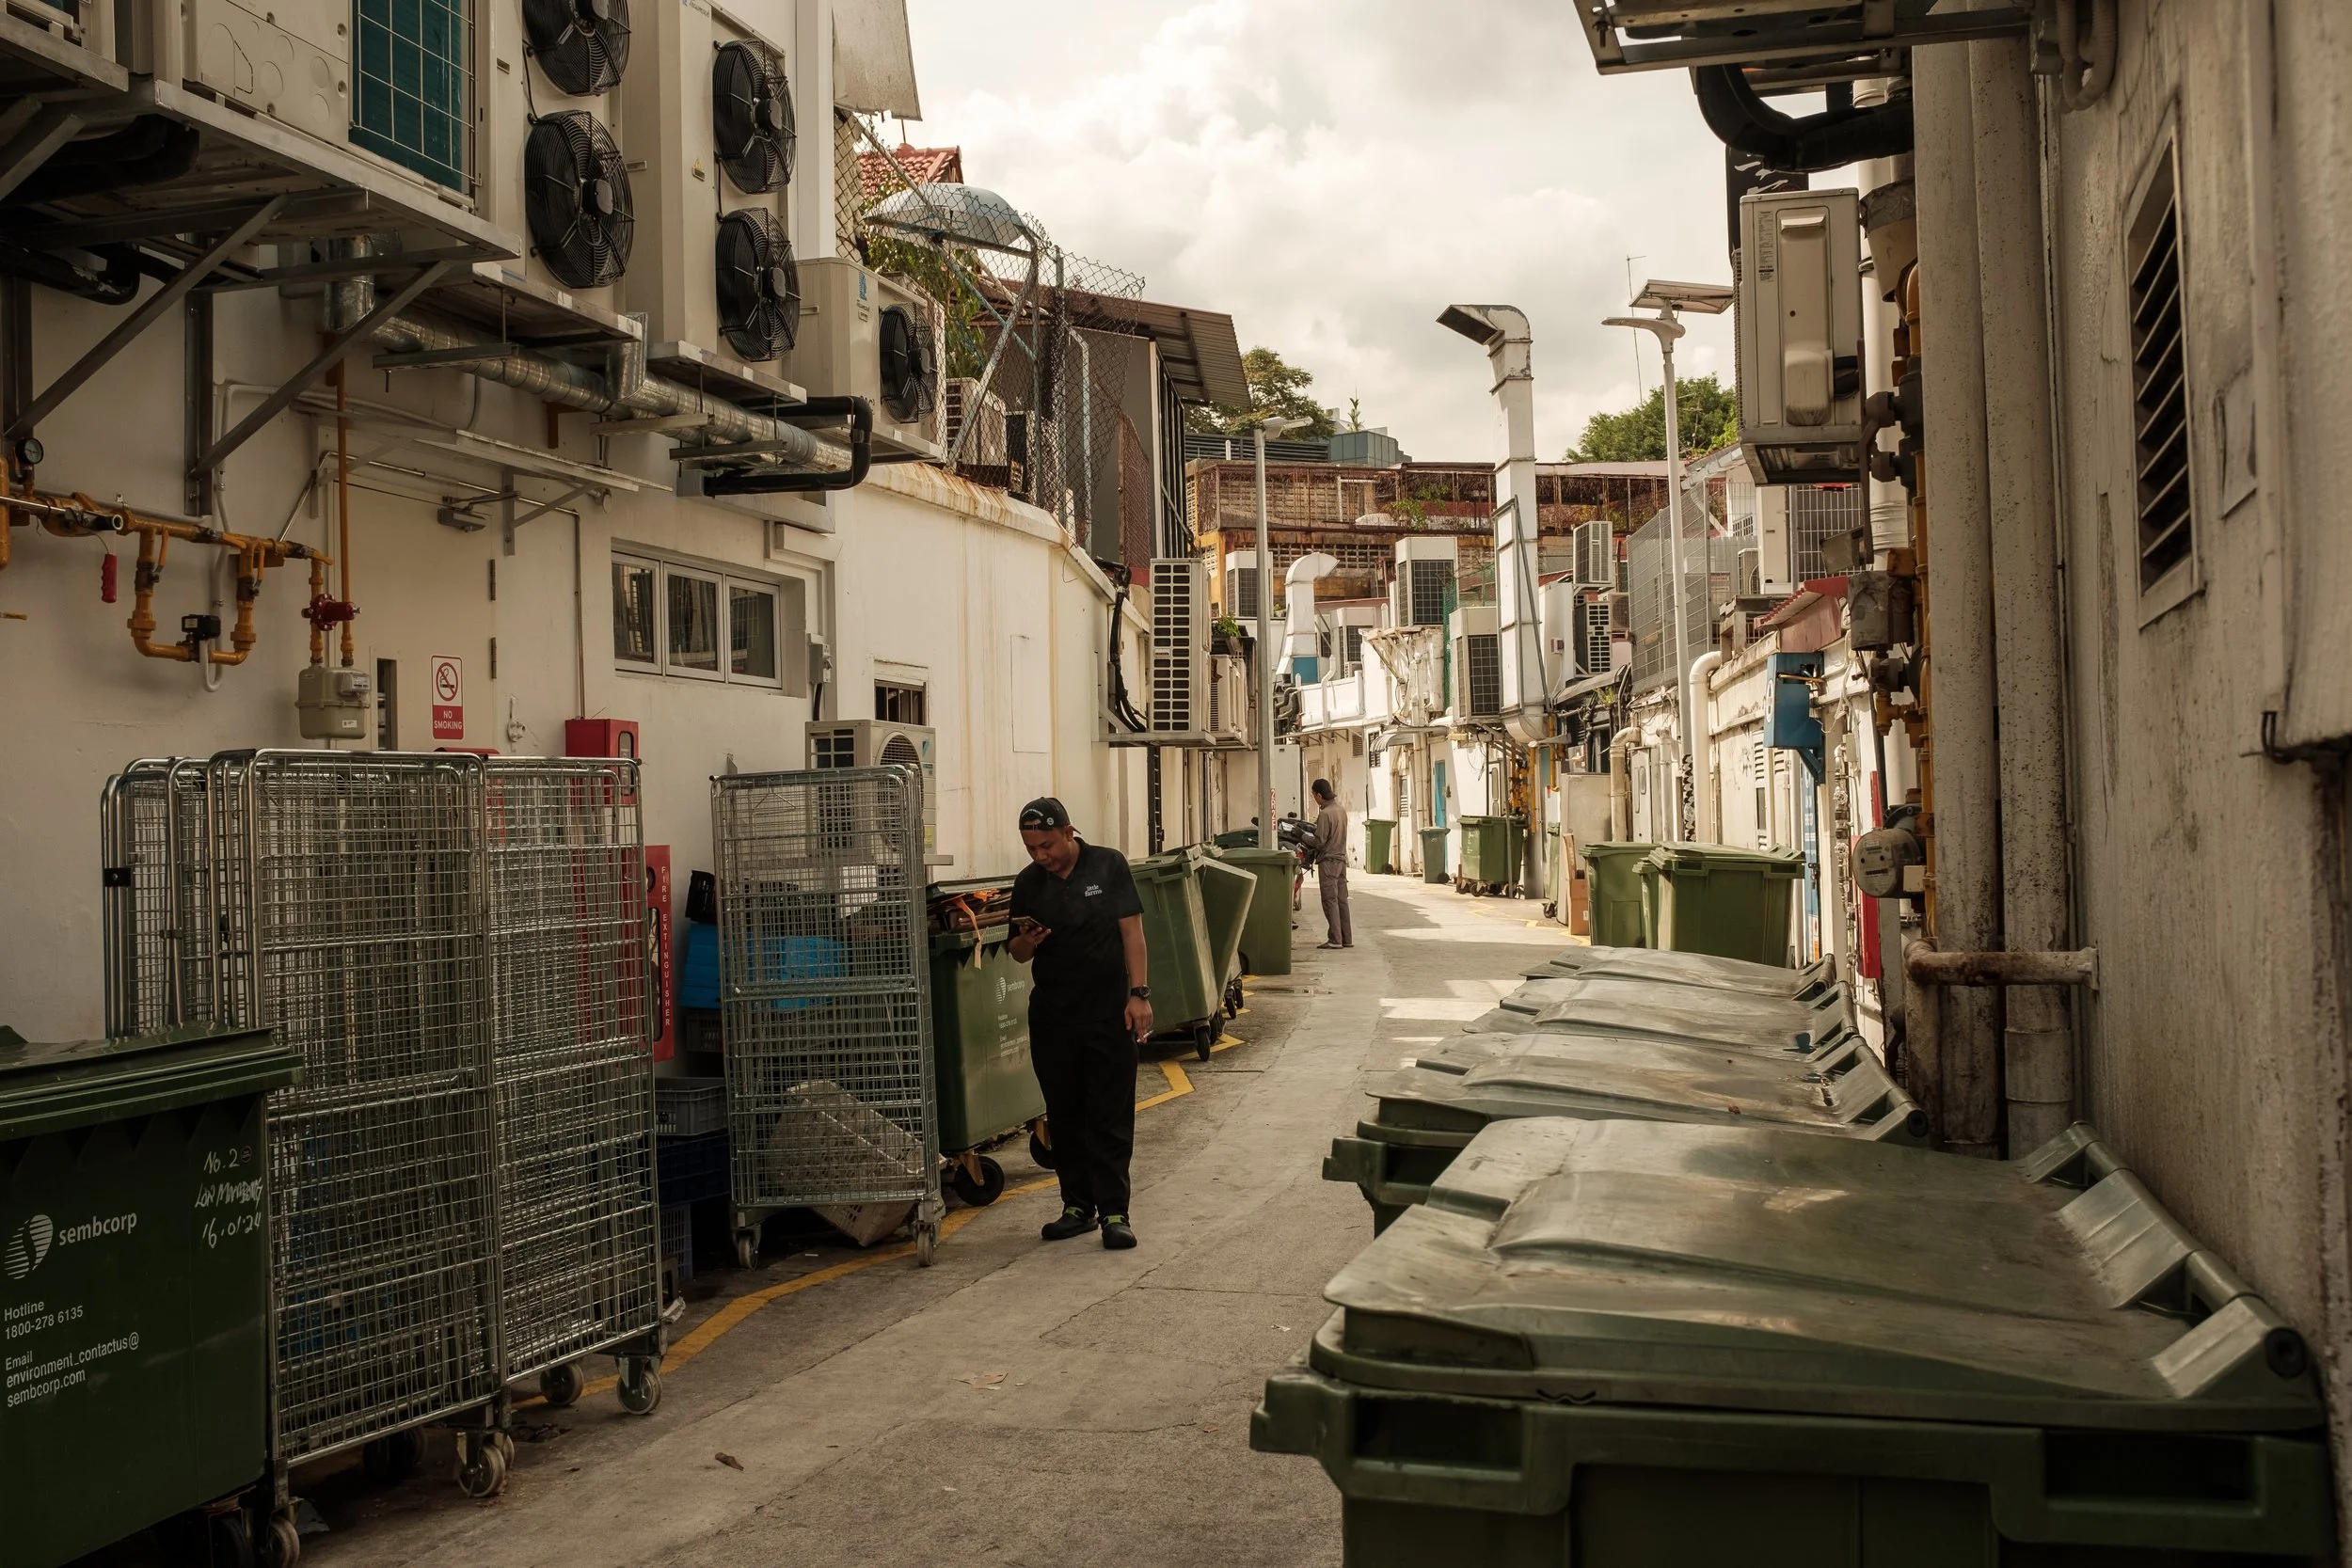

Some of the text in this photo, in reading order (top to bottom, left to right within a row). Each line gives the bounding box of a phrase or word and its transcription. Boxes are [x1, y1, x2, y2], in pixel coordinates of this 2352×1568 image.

[434, 721, 463, 730] SMOKING
[443, 710, 453, 720] NO
[662, 913, 671, 1026] EXTINGUISHER
[59, 1212, 137, 1246] sembcorp
[4, 1301, 45, 1322] Hotline
[5, 1305, 84, 1339] 1800-278 6135
[6, 1350, 33, 1371] Email
[7, 1331, 139, 1388] environment_contactus@
[7, 1369, 86, 1408] sembcorp.com
